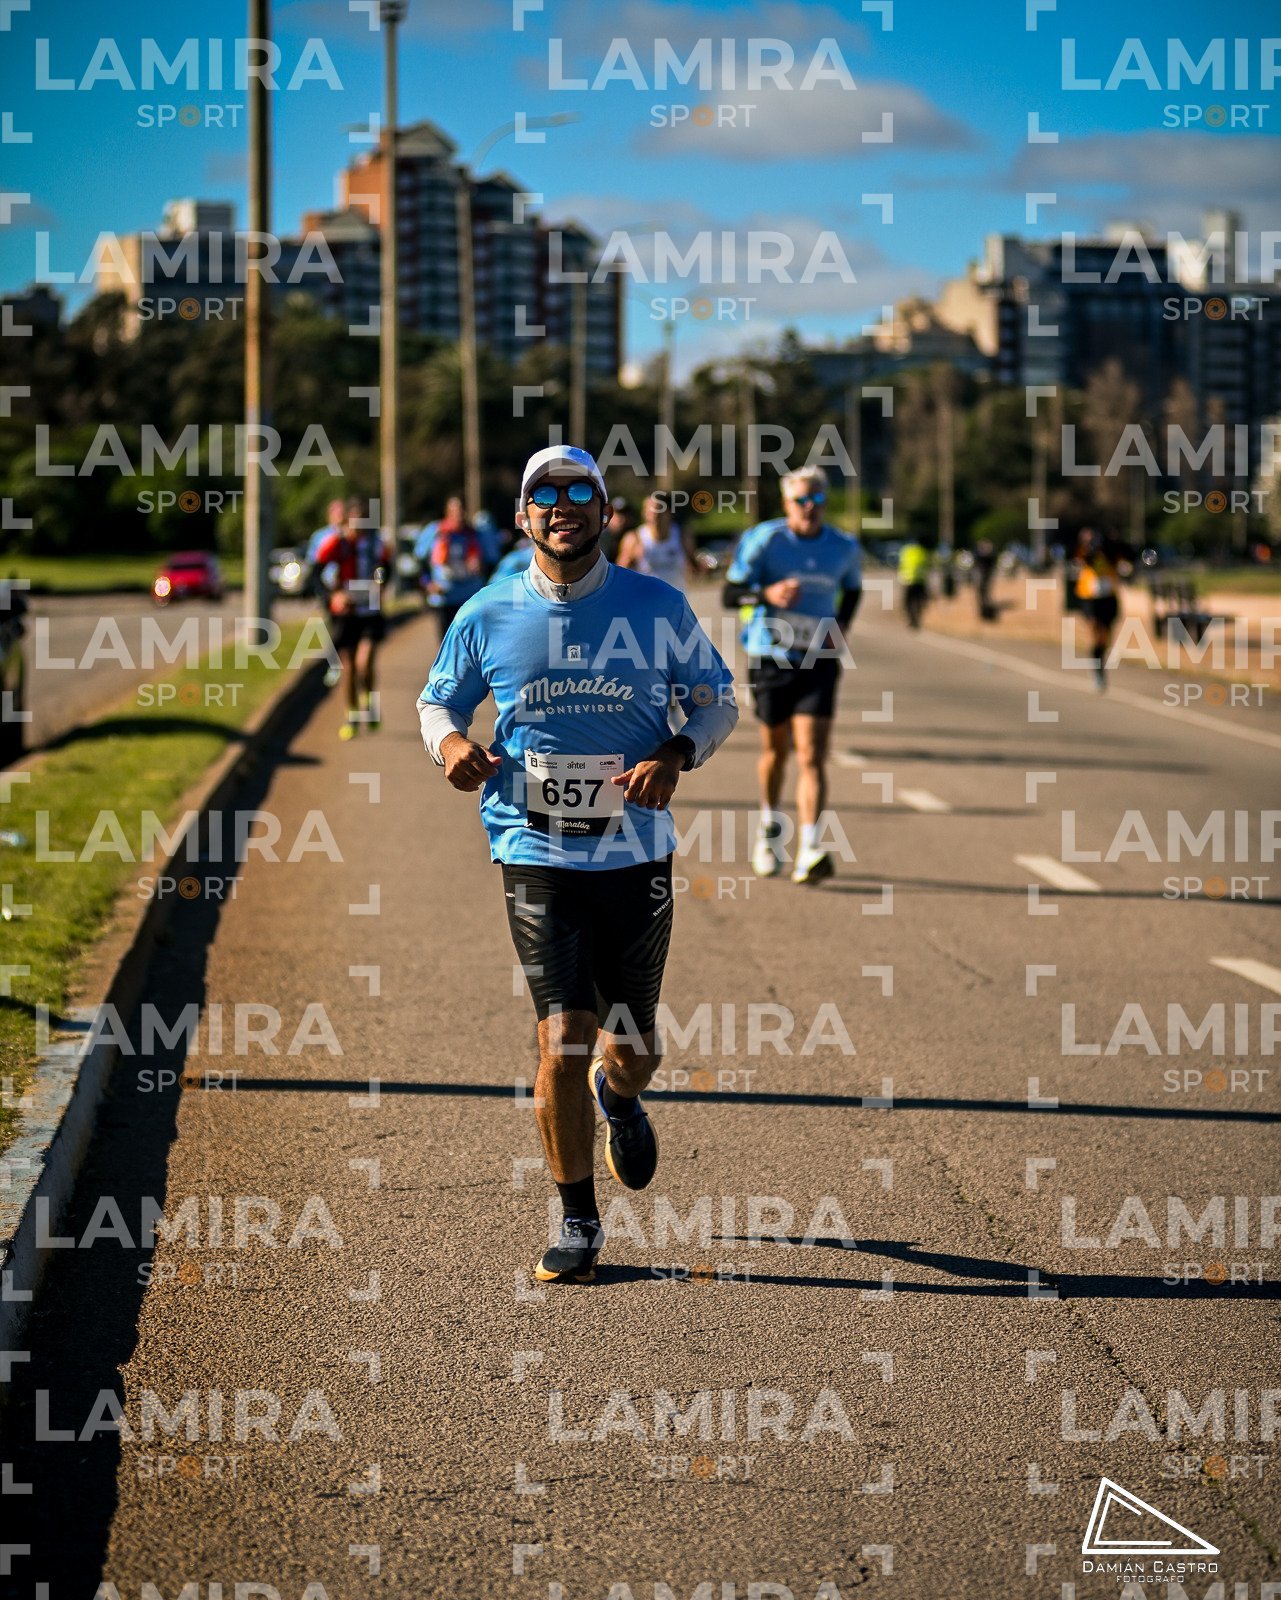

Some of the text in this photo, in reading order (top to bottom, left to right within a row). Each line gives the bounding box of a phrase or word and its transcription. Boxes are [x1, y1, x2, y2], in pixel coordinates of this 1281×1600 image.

[519, 675, 634, 705] Maratón
[535, 703, 625, 716] MONTEVIDEO
[542, 778, 604, 808] 657
